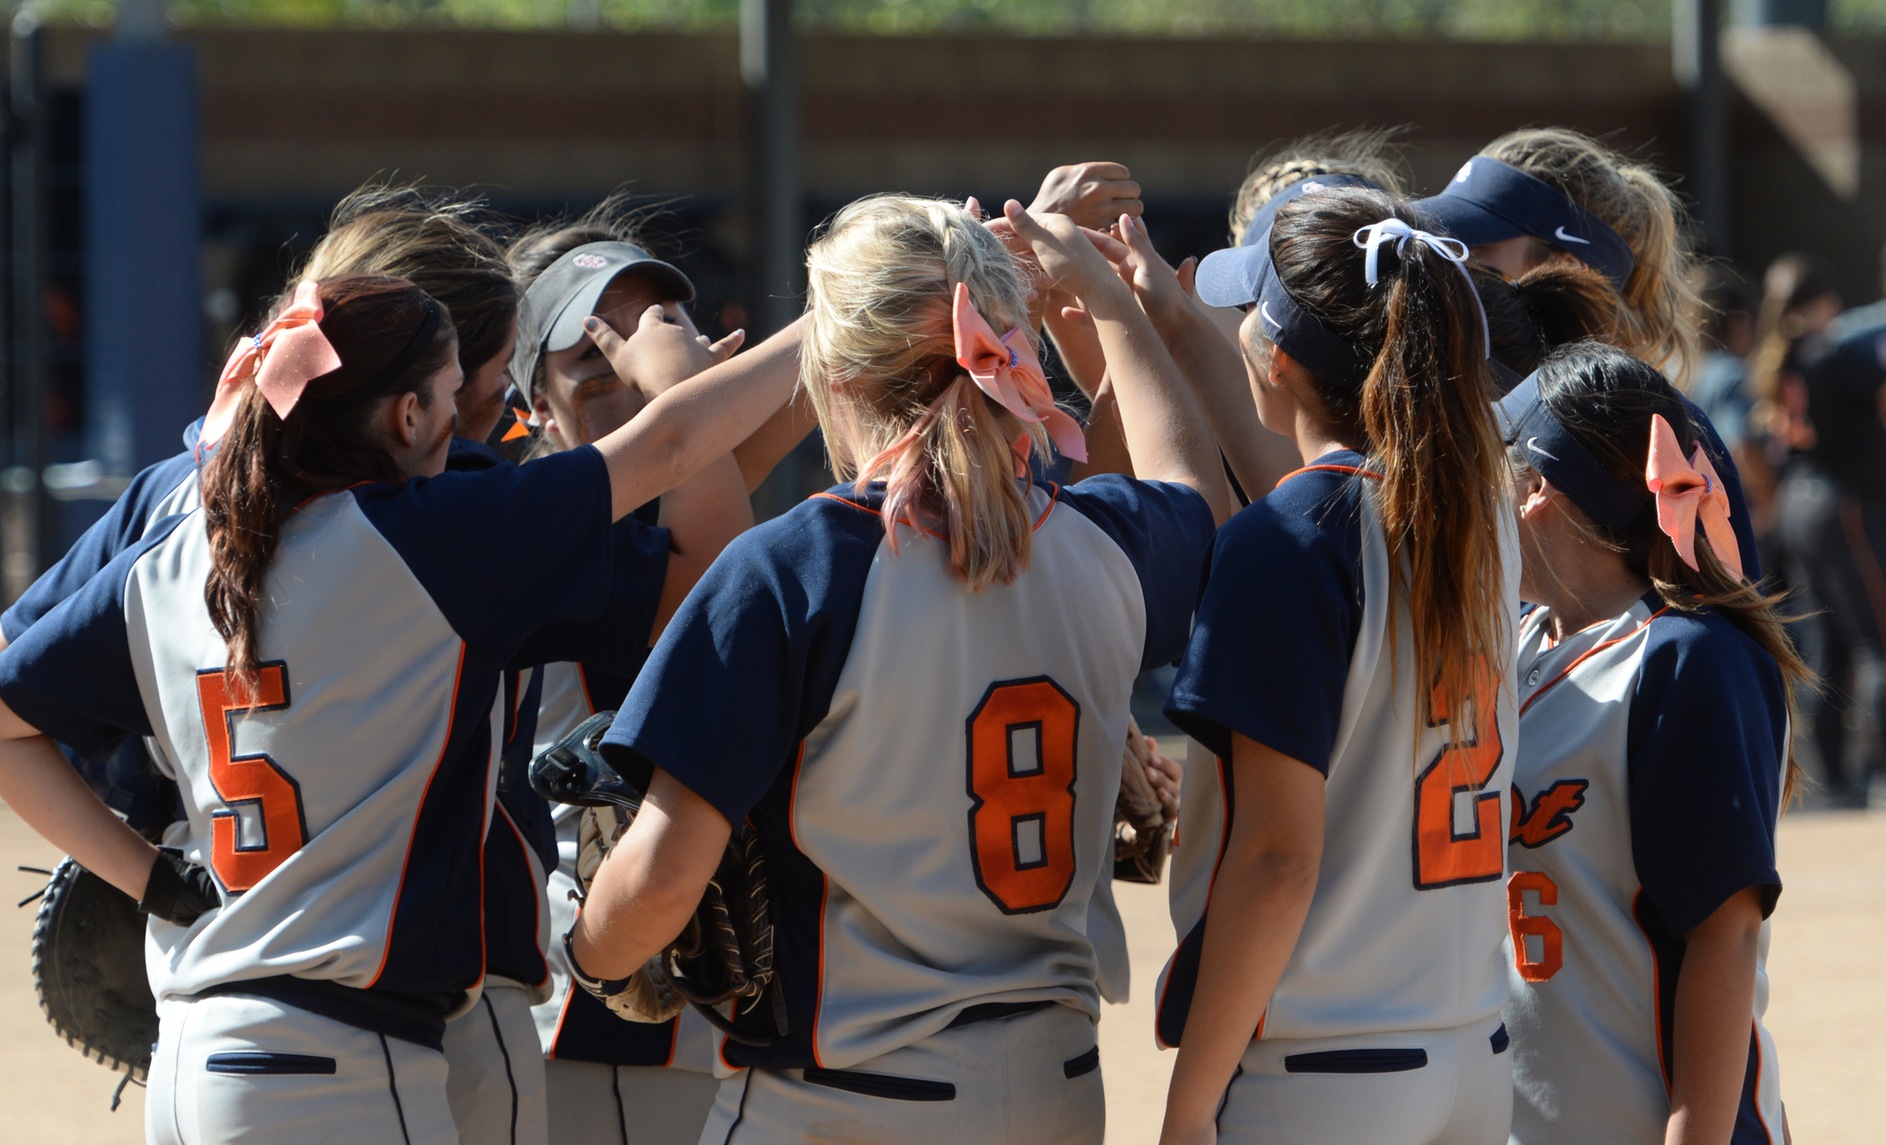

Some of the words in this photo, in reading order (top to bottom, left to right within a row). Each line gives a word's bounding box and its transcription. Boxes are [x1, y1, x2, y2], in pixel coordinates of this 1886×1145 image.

[196, 660, 309, 897] 5
[965, 674, 1081, 915] 8
[1412, 648, 1504, 891] 2
[1507, 871, 1563, 983] 6
